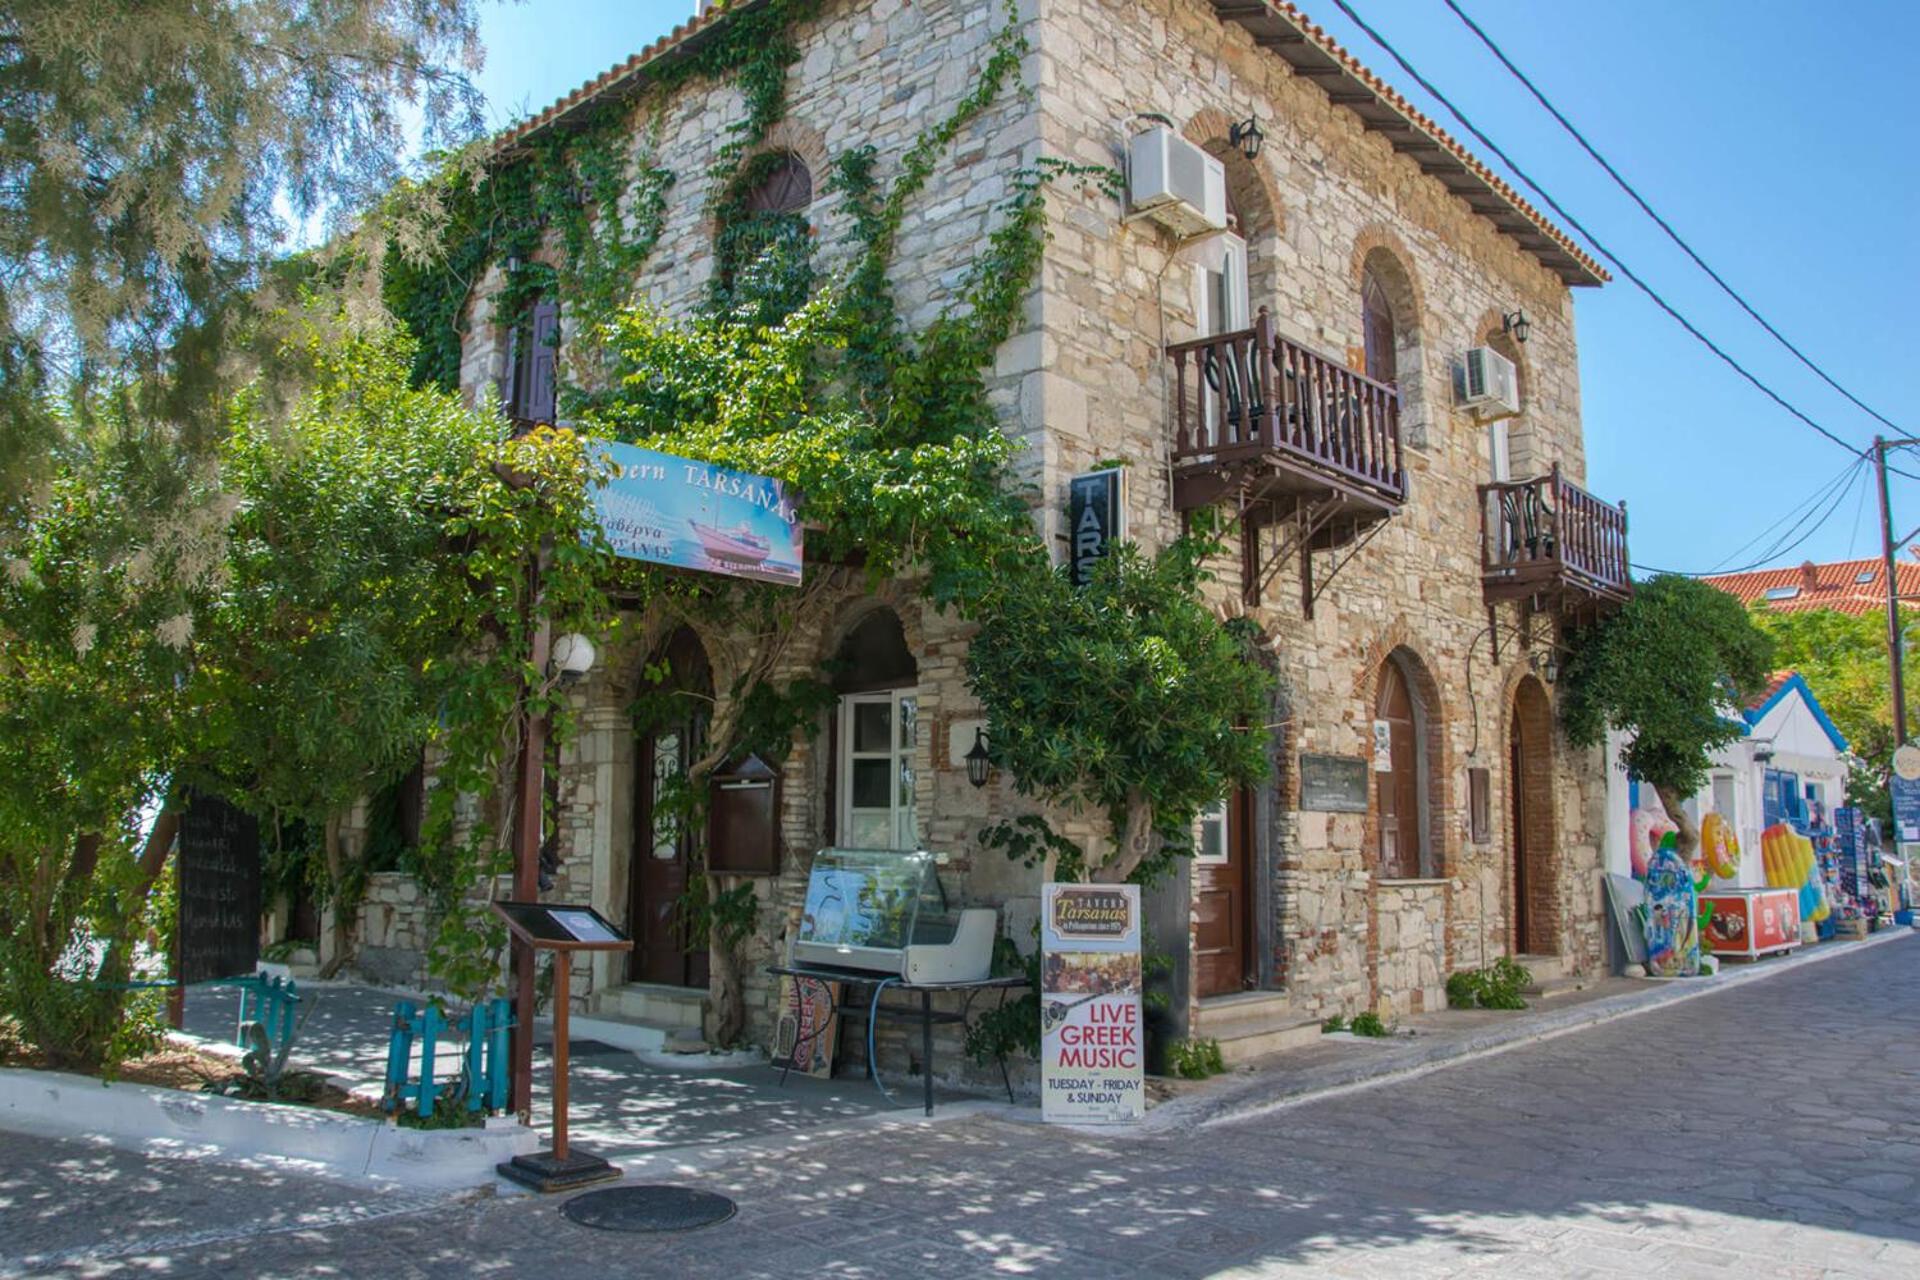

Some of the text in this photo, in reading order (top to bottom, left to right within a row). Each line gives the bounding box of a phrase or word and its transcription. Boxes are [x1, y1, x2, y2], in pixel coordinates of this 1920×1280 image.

[683, 465, 799, 524] TARSANAS
[1056, 898, 1127, 920] Tarsanas
[1090, 1004, 1136, 1024] LIVE
[1060, 1025, 1136, 1046] GREEK
[1059, 1048, 1137, 1068] MUSIC
[1048, 1078, 1095, 1090] TUESDAY
[1103, 1079, 1140, 1091] FRIDAY
[1066, 1093, 1122, 1104] & SUNDAY
